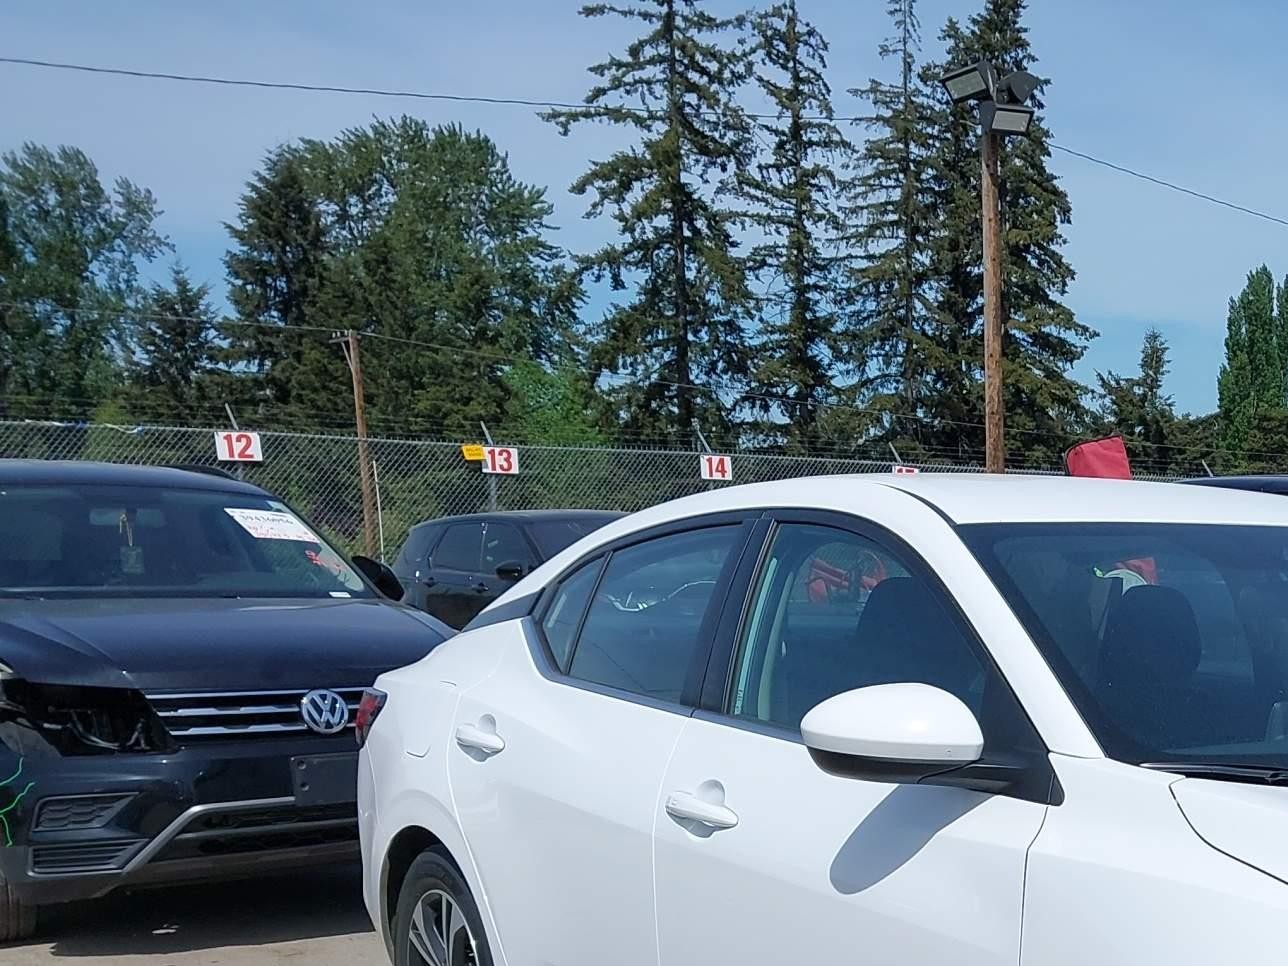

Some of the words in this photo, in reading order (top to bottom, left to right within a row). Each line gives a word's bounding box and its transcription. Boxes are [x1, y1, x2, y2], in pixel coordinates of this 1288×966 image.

[223, 433, 255, 459] 12
[487, 448, 513, 472] 13
[705, 456, 728, 478] 14
